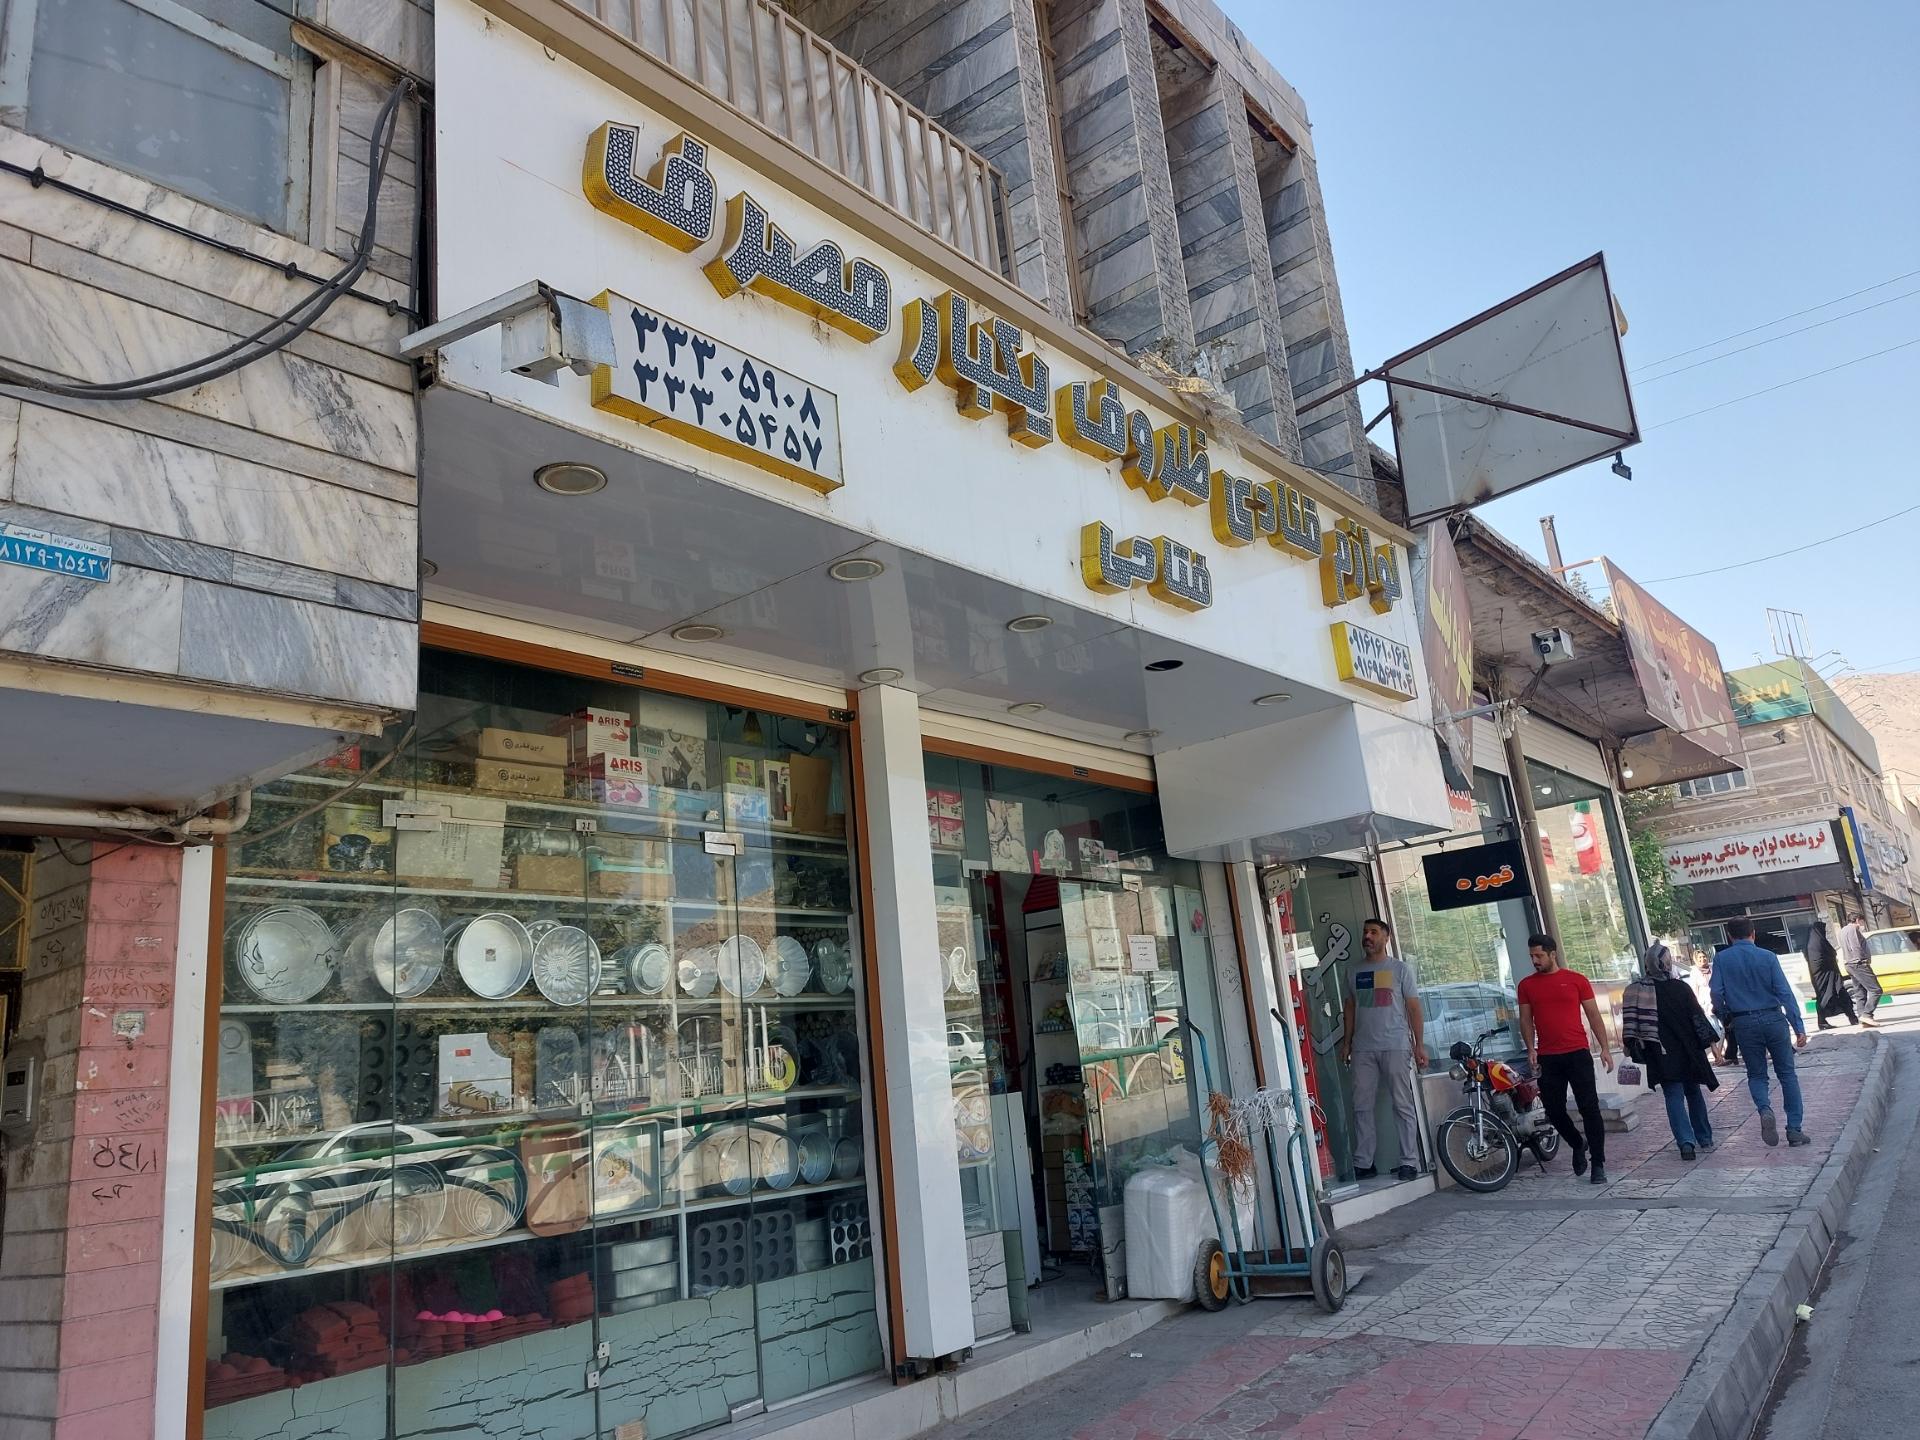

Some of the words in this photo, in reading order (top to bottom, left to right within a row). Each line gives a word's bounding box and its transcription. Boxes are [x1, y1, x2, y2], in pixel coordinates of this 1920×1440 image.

[584, 119, 892, 342] مصرف
[630, 306, 821, 430] ۳۳۳۰۵۹۰۸
[895, 288, 1053, 448] یکبار
[632, 359, 823, 471] ۳۳۳۰۵۴۵۷
[1056, 378, 1212, 502] ظروف
[1212, 470, 1322, 560] قنادی
[1081, 519, 1213, 613] فتاحی
[1321, 519, 1402, 614] لوازم
[598, 716, 621, 727] ARIS
[609, 757, 643, 773] ARIS
[1456, 864, 1515, 891] قهوه
[1714, 841, 1750, 864] خانگی
[1752, 836, 1778, 860] لوازم
[1780, 828, 1825, 850] فروشگاه
